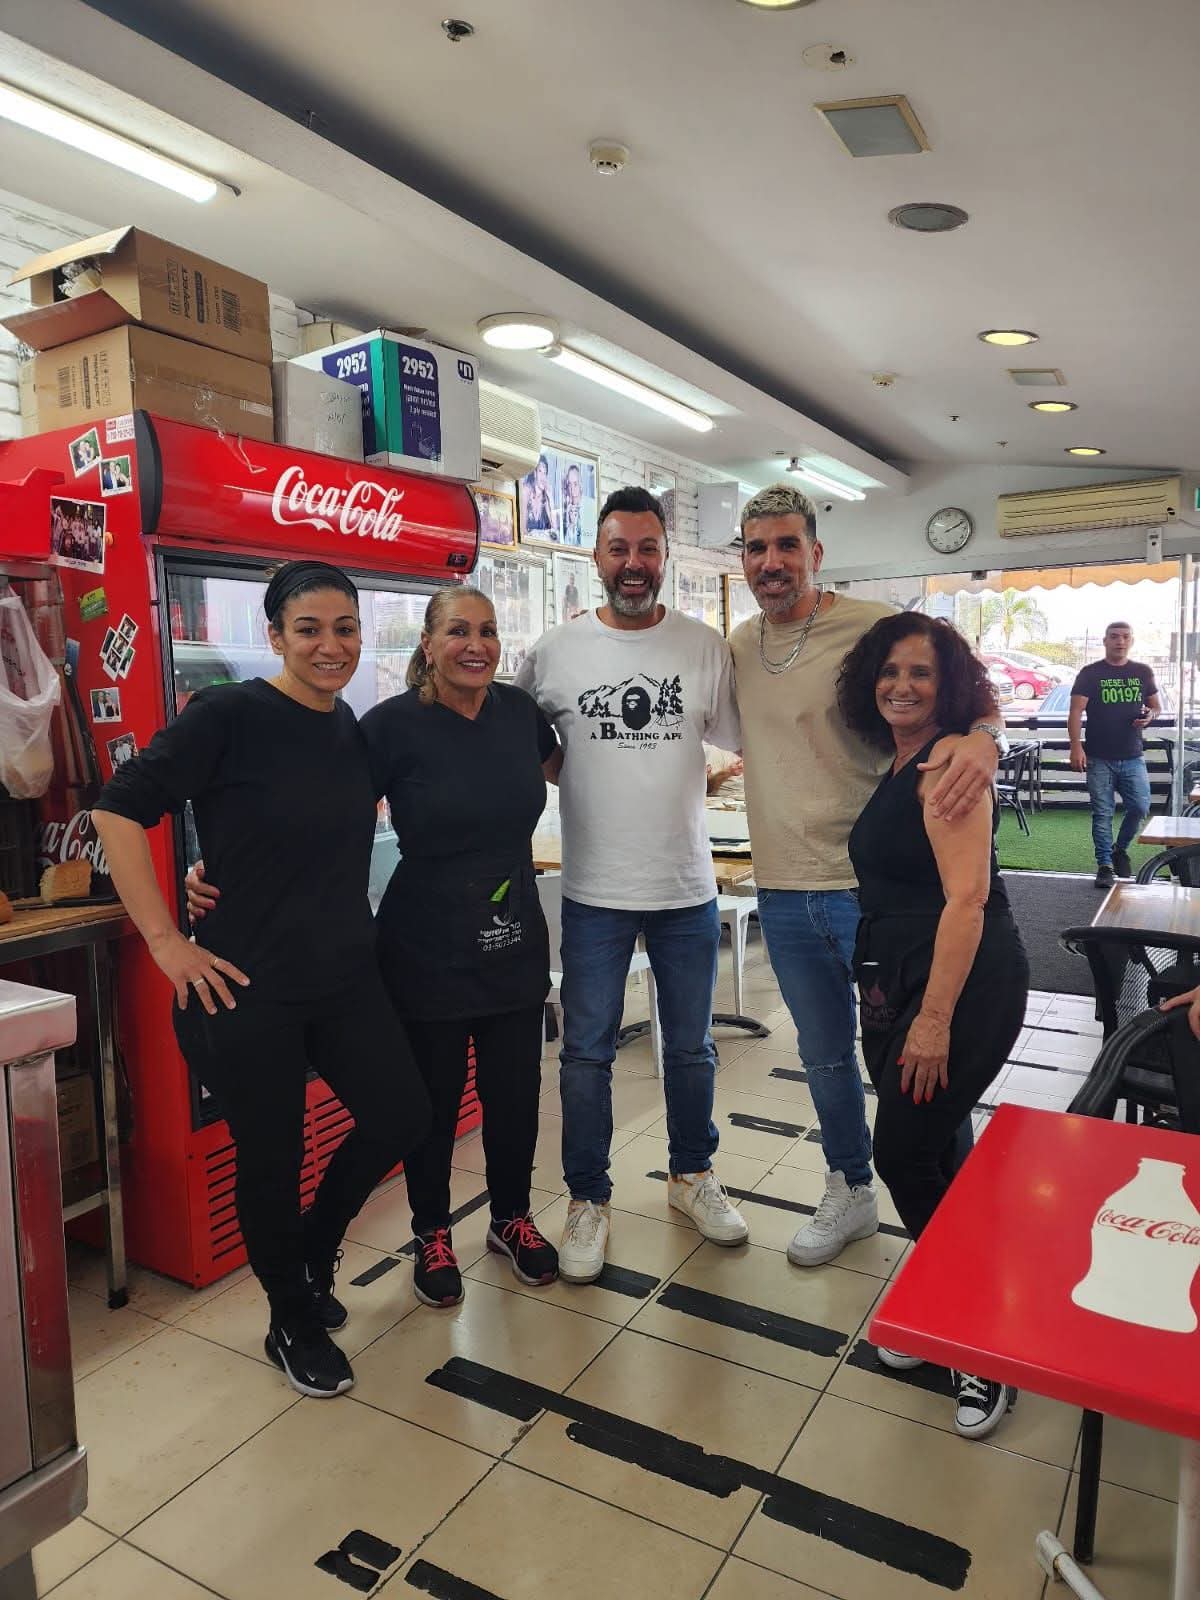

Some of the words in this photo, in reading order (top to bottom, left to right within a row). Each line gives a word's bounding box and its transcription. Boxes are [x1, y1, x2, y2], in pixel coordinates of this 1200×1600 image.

[336, 350, 367, 379] 2952
[401, 355, 435, 380] 2952
[271, 465, 405, 542] Coca-Cola
[1100, 679, 1126, 687] DIESEL
[590, 732, 597, 740] A
[1097, 1208, 1200, 1246] Coca-Cola
